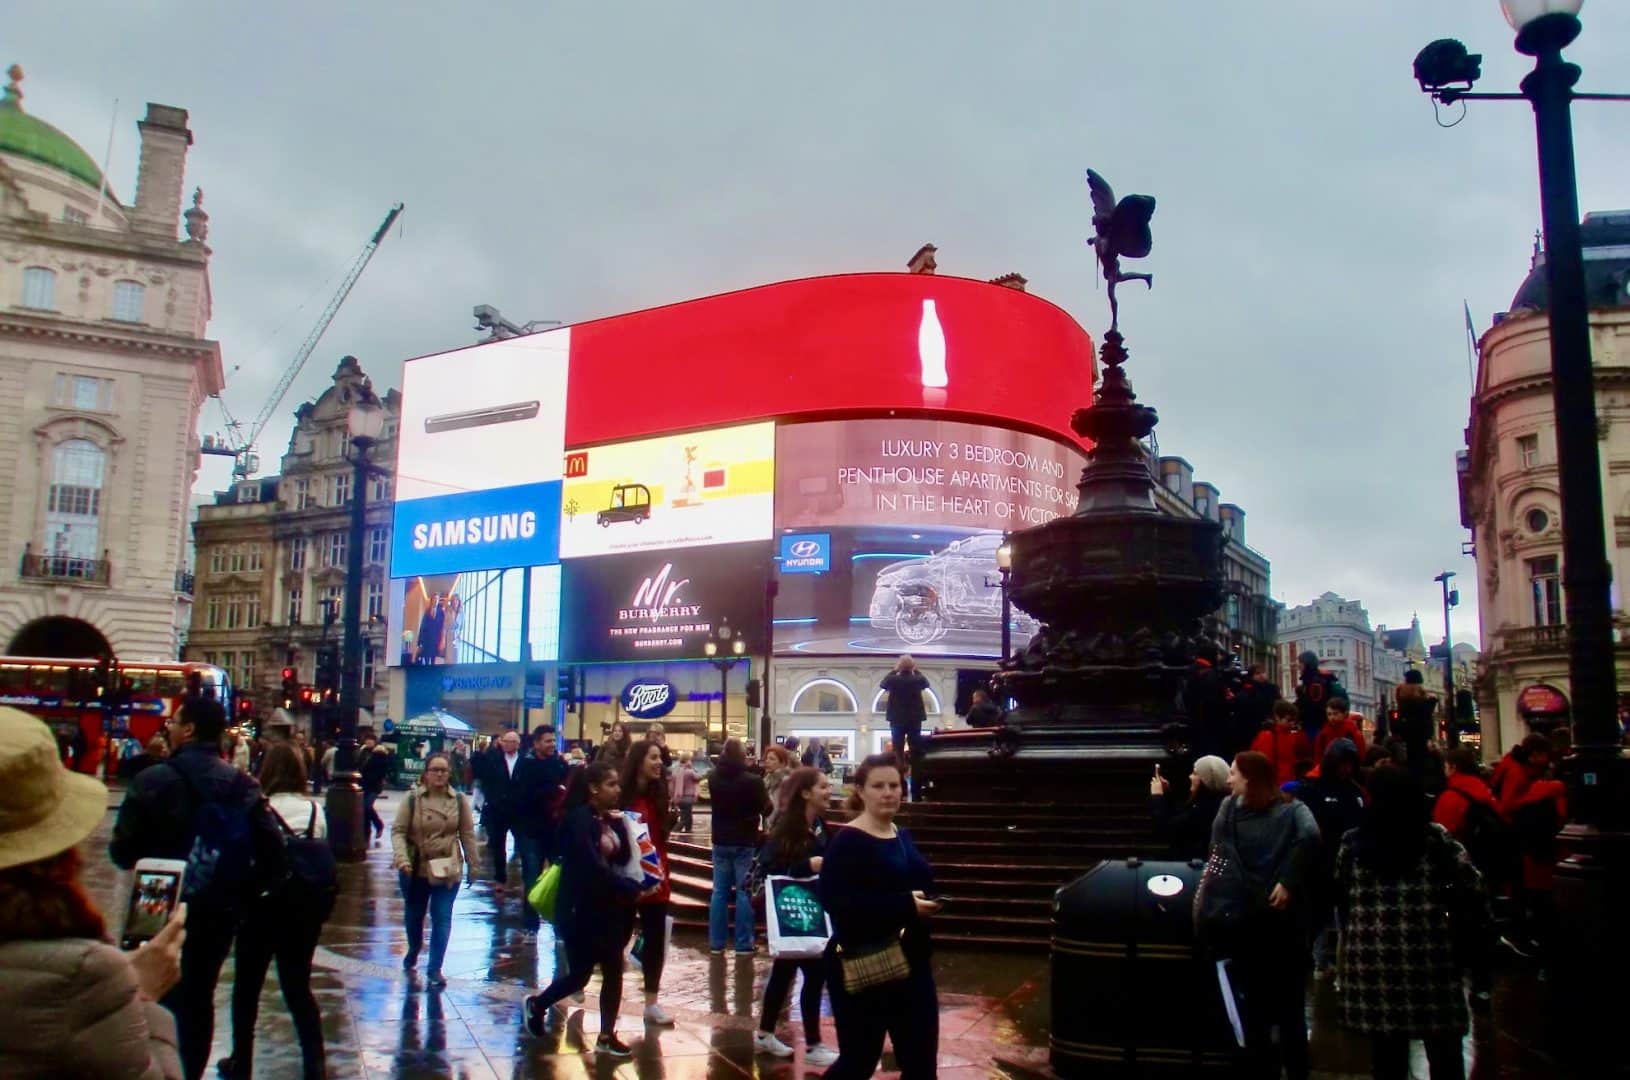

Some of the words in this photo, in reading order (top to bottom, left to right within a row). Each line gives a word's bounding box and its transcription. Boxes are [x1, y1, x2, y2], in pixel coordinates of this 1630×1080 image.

[882, 439, 943, 458] LUXURY
[949, 442, 959, 459] 3
[965, 444, 1038, 472] BEDROOM
[1041, 459, 1064, 479] AND
[838, 466, 945, 485] PENTHOUSE
[950, 470, 1042, 499] APARTMENTS
[1045, 484, 1064, 505] FOR
[877, 493, 897, 511] IN
[903, 494, 935, 512] THE
[941, 495, 991, 517] HEART
[994, 501, 1016, 519] OF
[413, 511, 536, 550] SAMSUNG
[786, 558, 824, 567] HYUNDAI
[633, 563, 689, 622] Mr.
[619, 605, 701, 619] BURBERRY
[624, 627, 639, 635] NEW
[639, 625, 679, 633] FRAGRANCE
[680, 624, 694, 632] FOR
[695, 623, 711, 631] MEN
[634, 638, 683, 647] BURBERRY.COM
[626, 684, 669, 712] Boots
